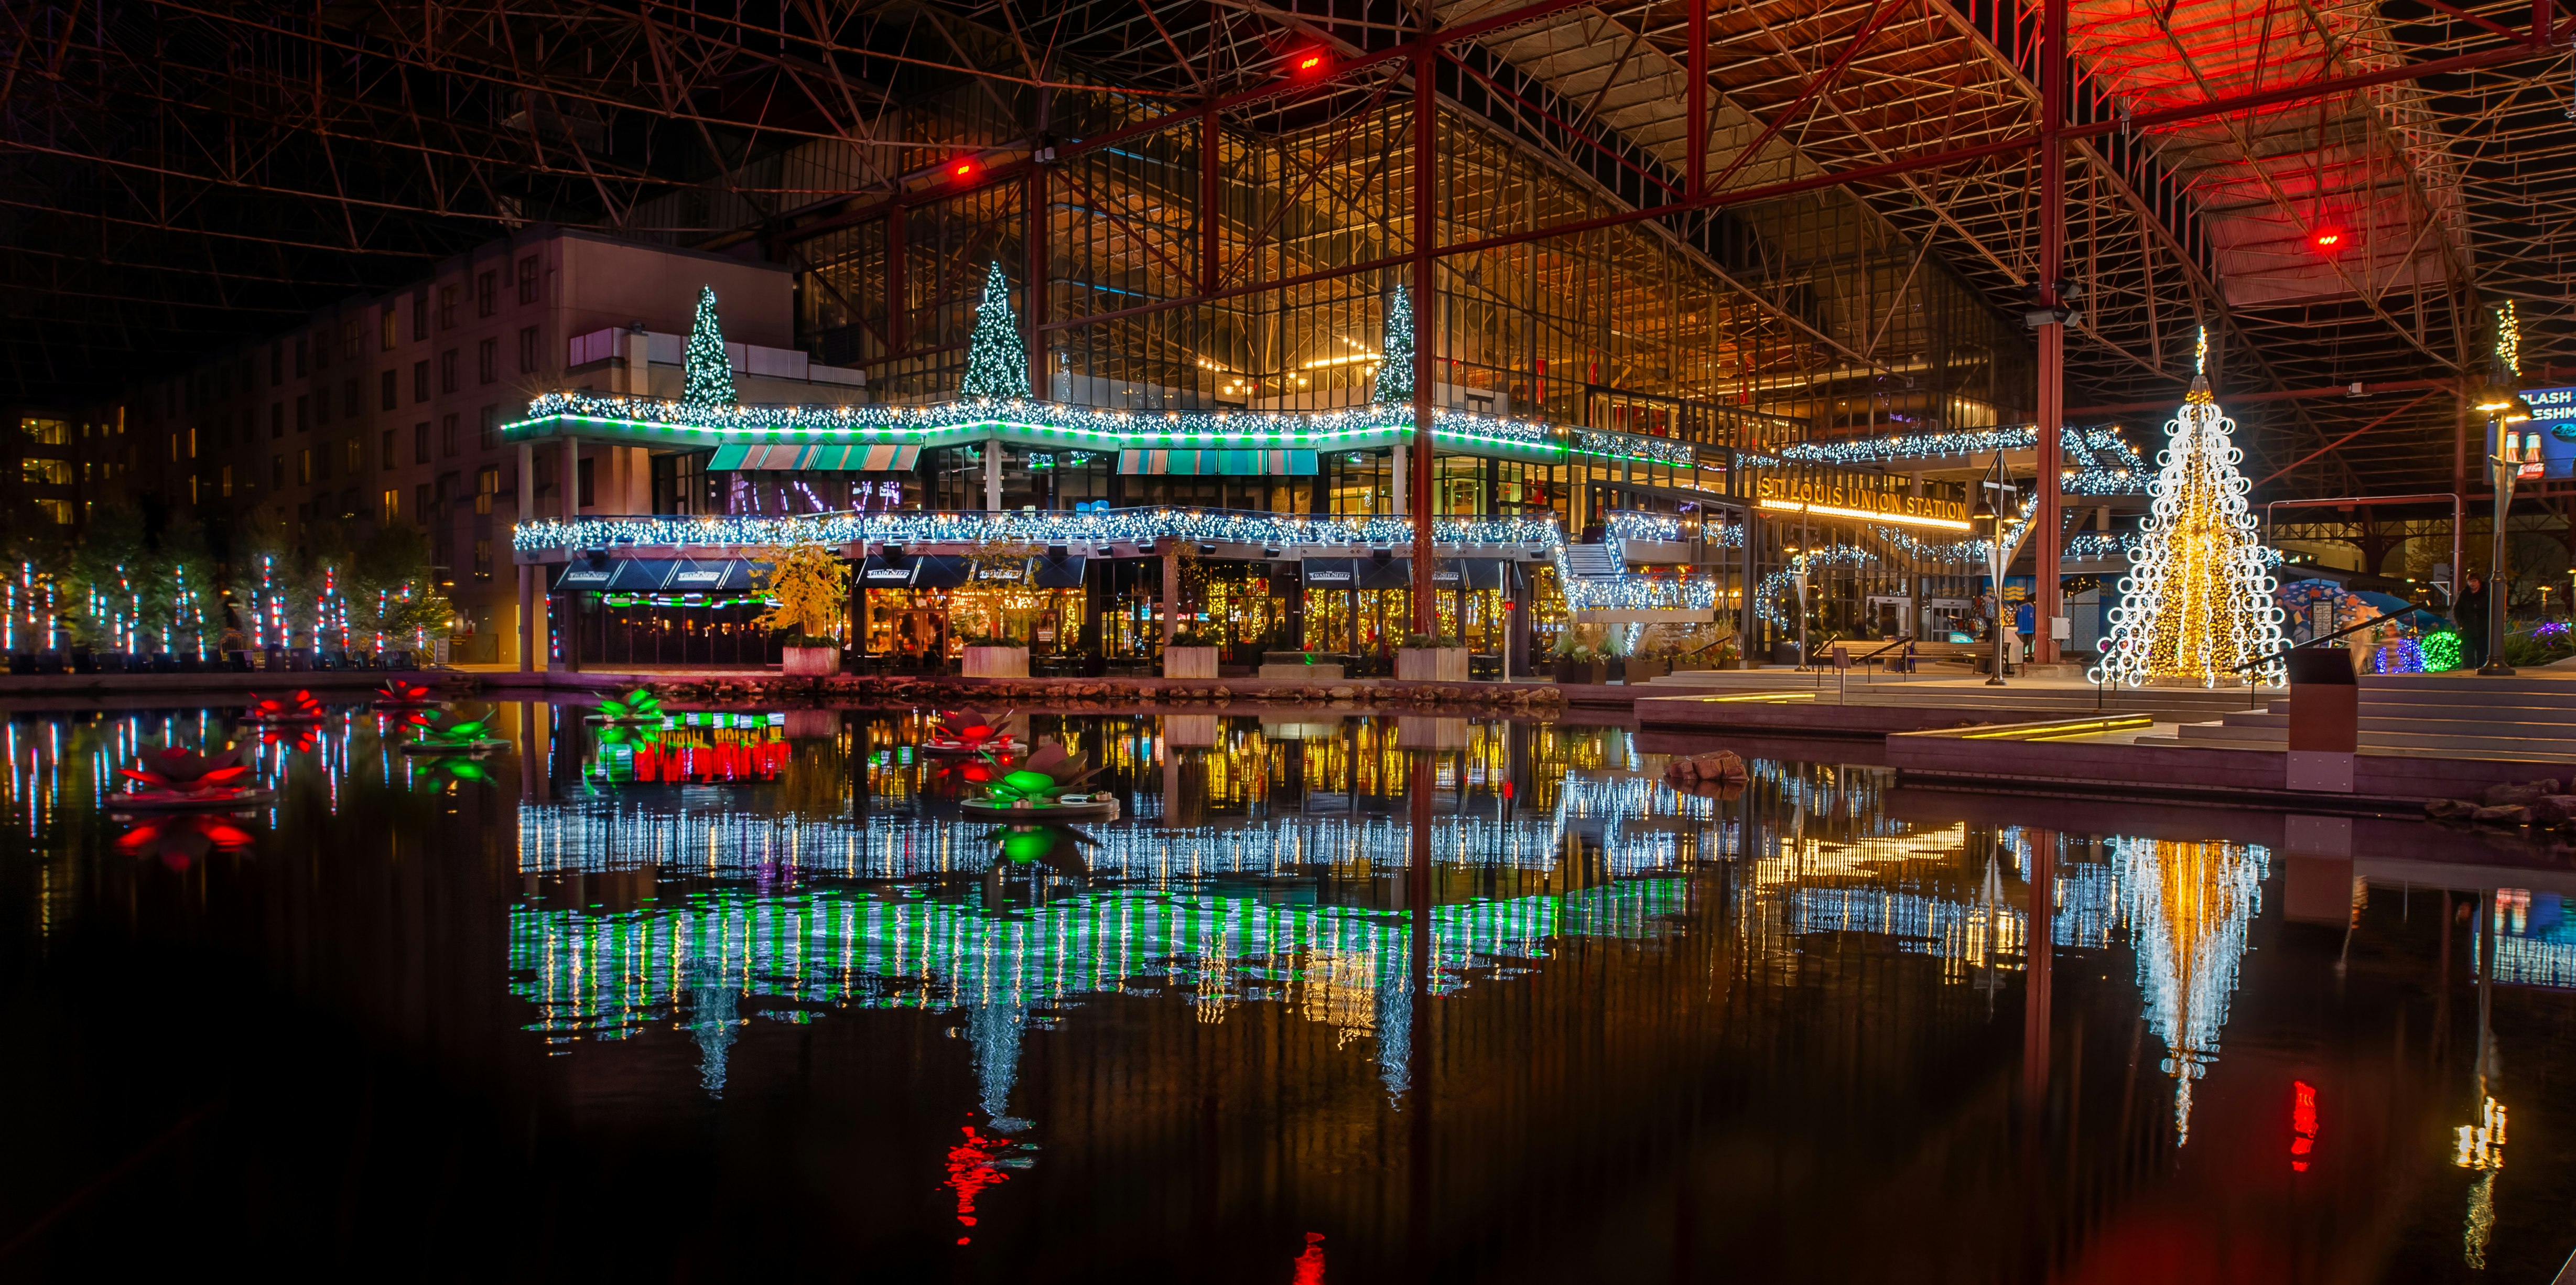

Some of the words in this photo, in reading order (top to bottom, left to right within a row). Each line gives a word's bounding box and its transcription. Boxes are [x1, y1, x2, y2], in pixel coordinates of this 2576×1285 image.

[1760, 476, 1784, 499] ST.
[1790, 479, 1843, 505] LOUIS
[1849, 487, 1901, 513] UNION
[1907, 496, 1966, 520] STATION
